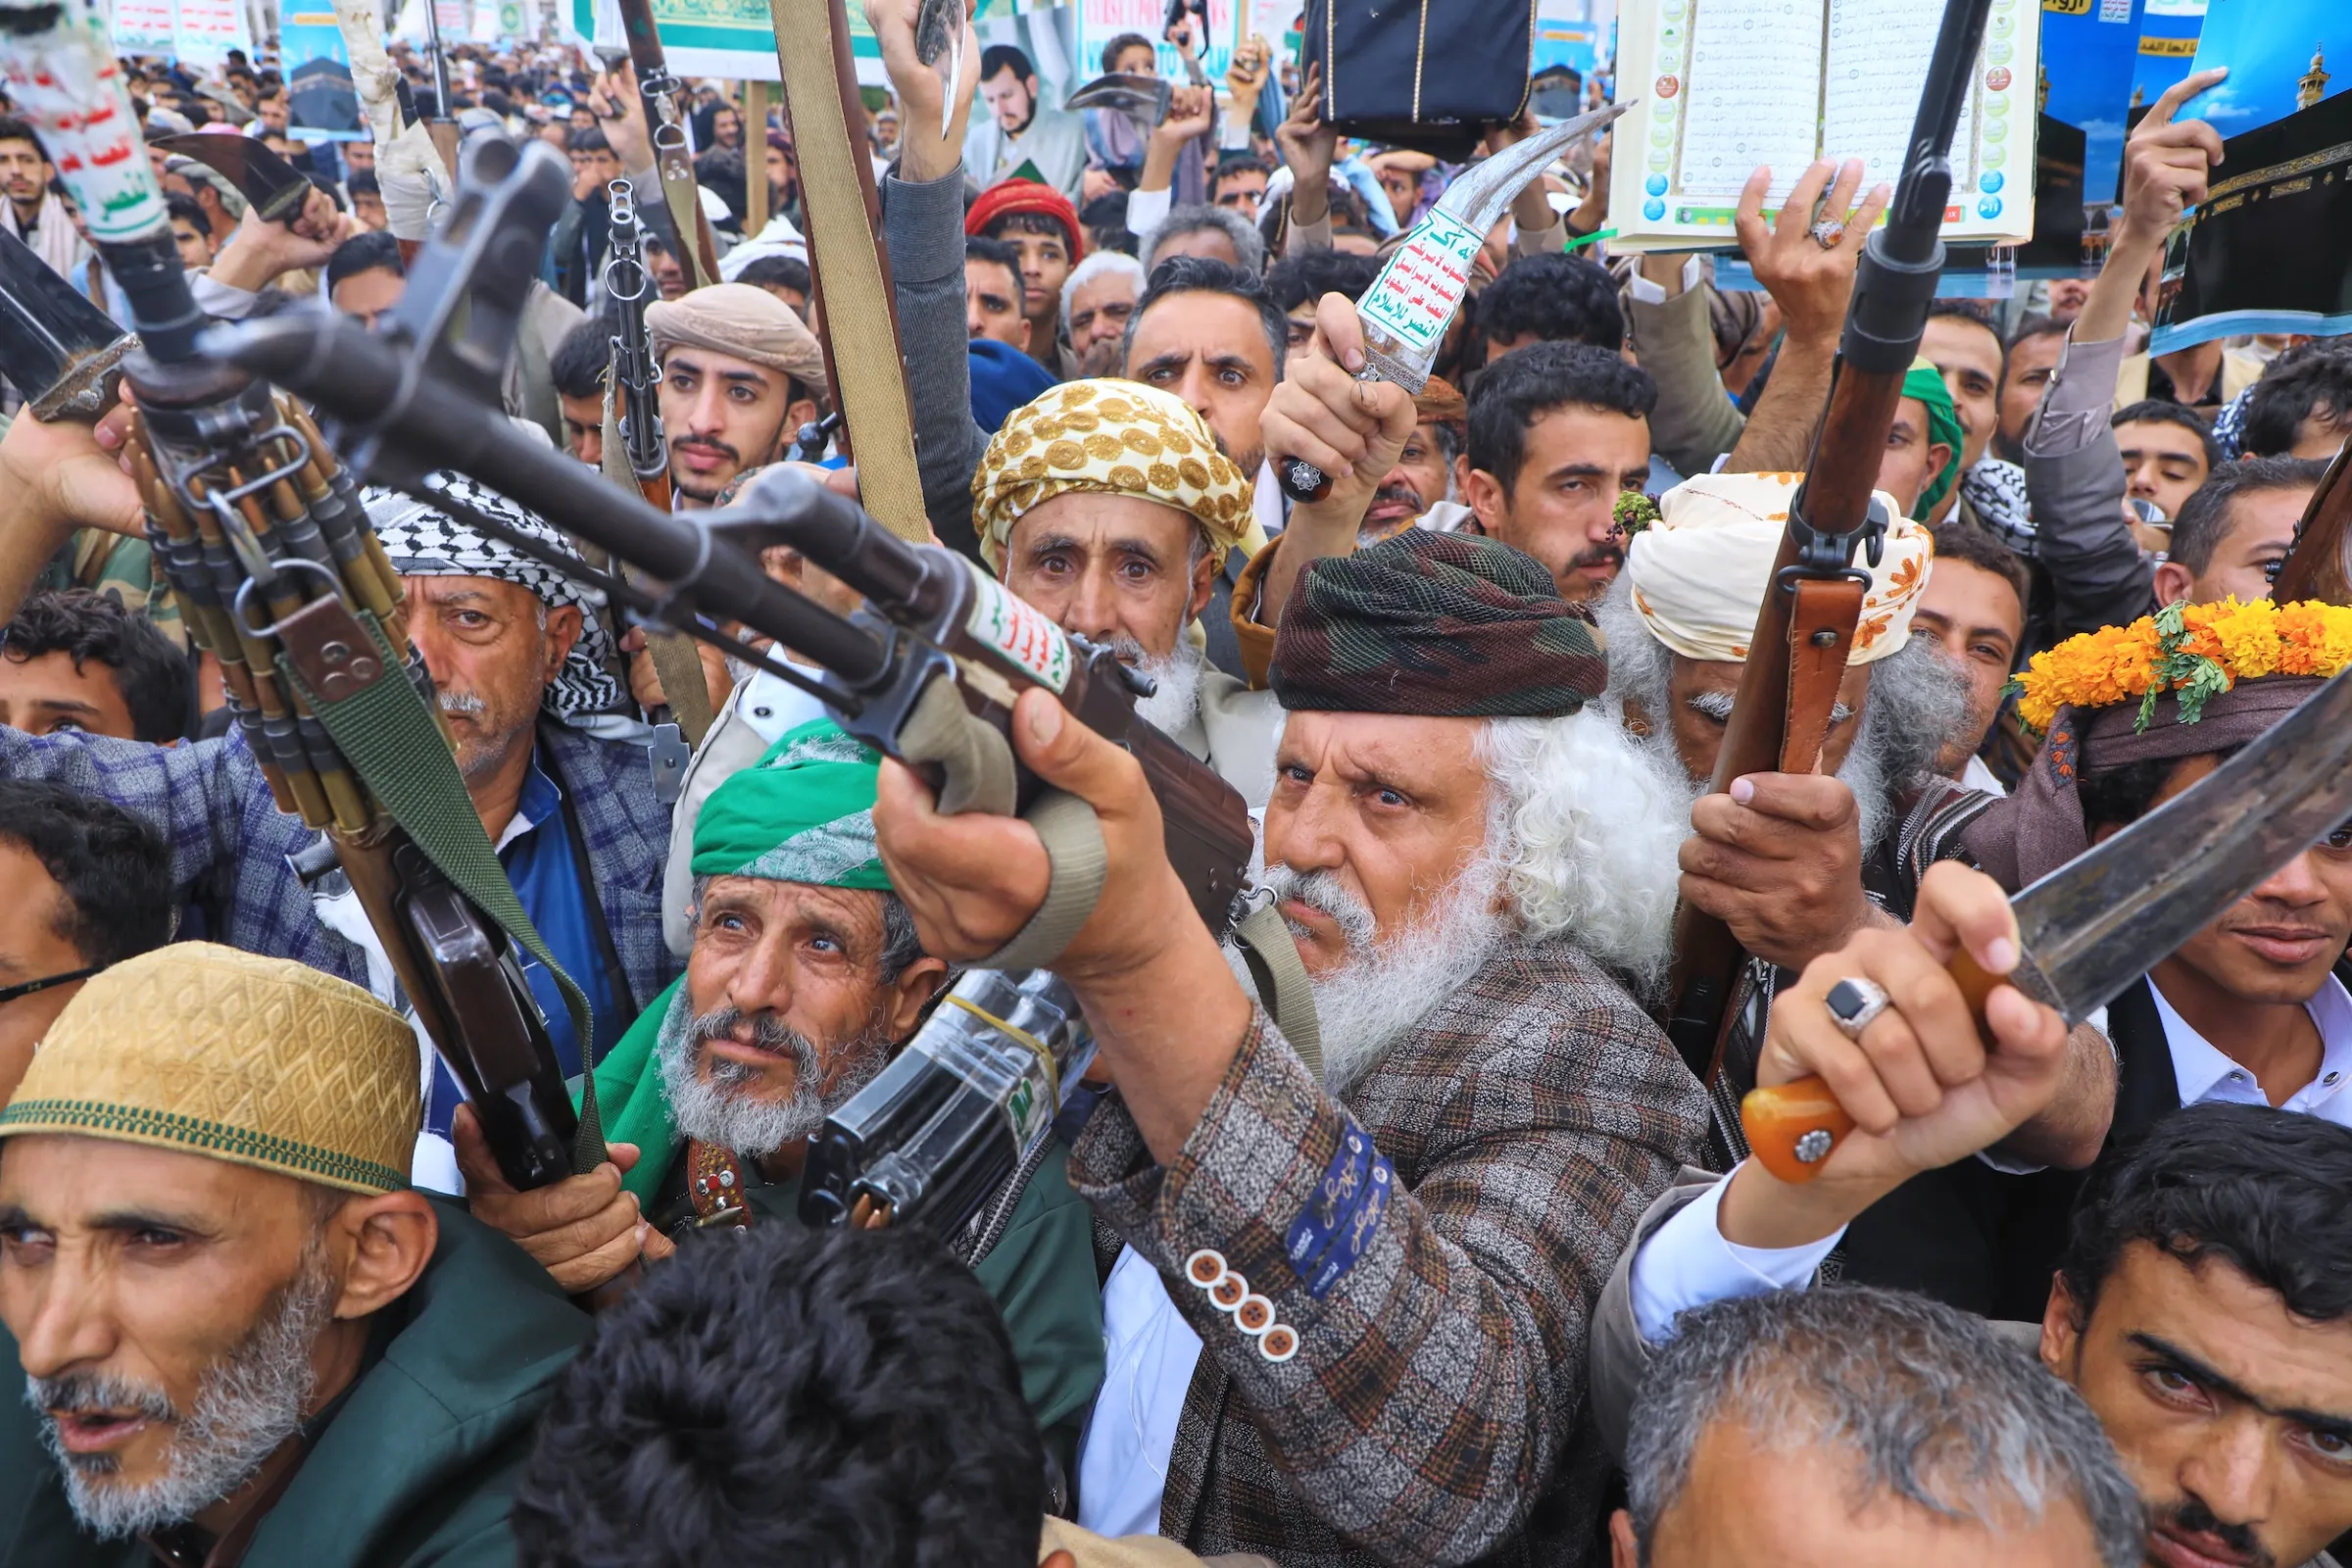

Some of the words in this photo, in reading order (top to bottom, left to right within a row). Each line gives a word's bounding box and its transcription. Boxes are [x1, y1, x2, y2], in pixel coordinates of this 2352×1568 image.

[1156, 44, 1178, 76] TO
[1408, 294, 1426, 306] على
[1426, 299, 1450, 321] اللعنة
[1402, 317, 1440, 339] النصر
